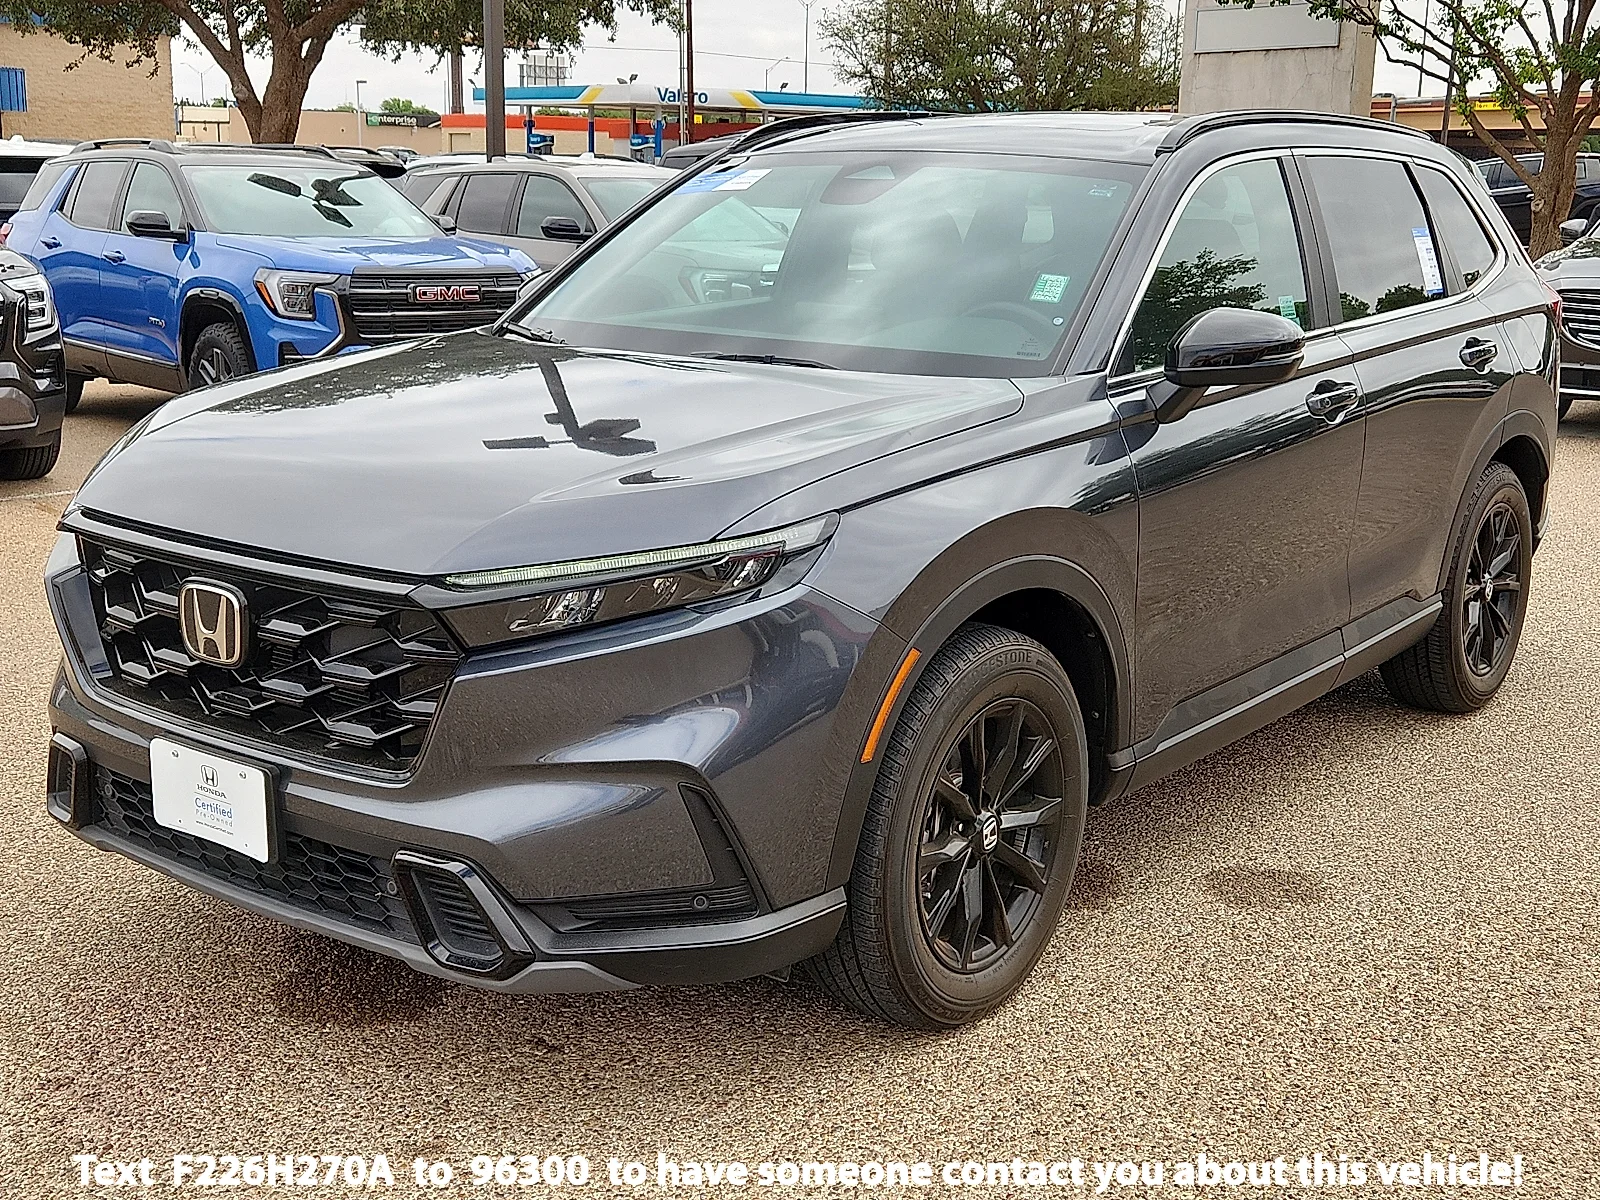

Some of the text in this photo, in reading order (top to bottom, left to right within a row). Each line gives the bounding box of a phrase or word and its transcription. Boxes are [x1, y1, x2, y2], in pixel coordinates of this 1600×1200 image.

[416, 285, 480, 301] GMC
[196, 783, 228, 799] HONDA
[194, 797, 233, 819] Certified
[195, 808, 233, 828] Pre-Owned
